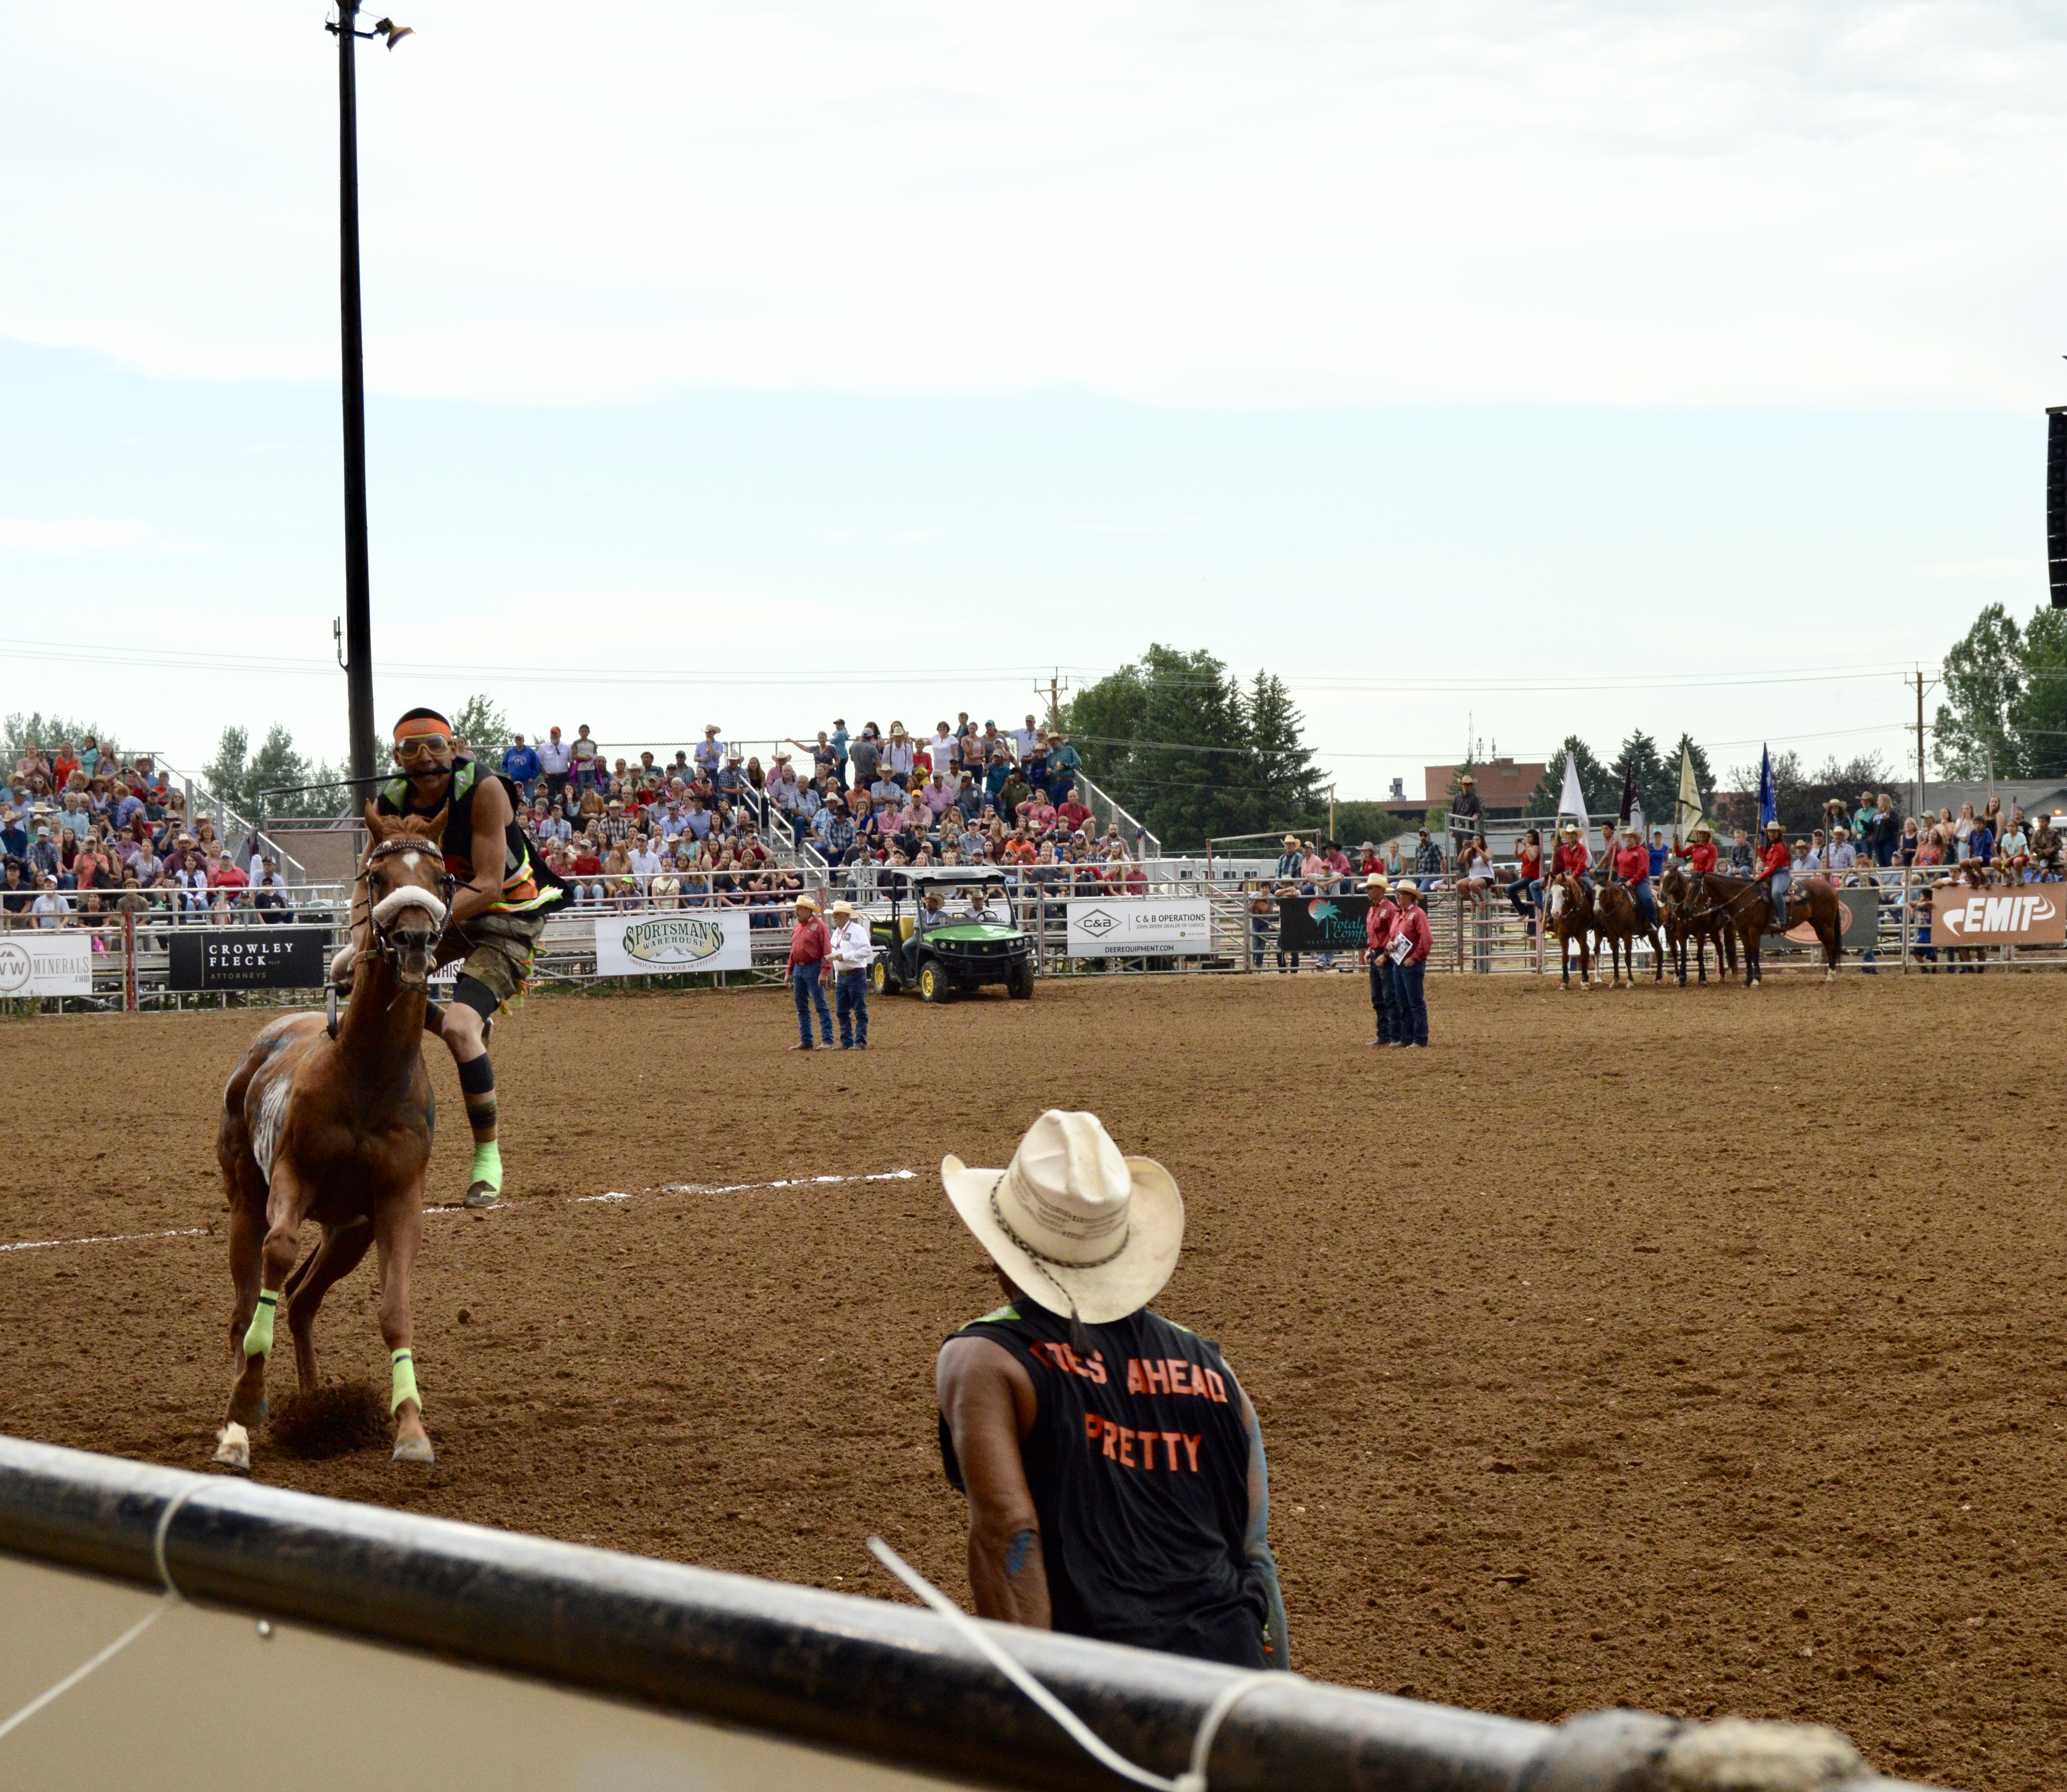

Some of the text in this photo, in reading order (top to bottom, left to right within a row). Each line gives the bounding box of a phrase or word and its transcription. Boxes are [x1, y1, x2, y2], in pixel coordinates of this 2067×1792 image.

[1159, 914, 1205, 922] OPERATIONS
[1963, 896, 2040, 932] EMIT
[1084, 919, 1112, 928] C&B
[1331, 916, 1362, 929] Total
[626, 922, 721, 956] SPORTSMAN'S
[643, 936, 704, 950] WAREHOUSE
[209, 943, 293, 954] CROWLEY
[1105, 945, 1174, 953] DEEREQUIPMENT.COM
[33, 957, 89, 974] MINERALS
[209, 956, 266, 966] FLECK
[1128, 1358, 1228, 1403] AHEAD
[1085, 1412, 1203, 1472] PRETTY
